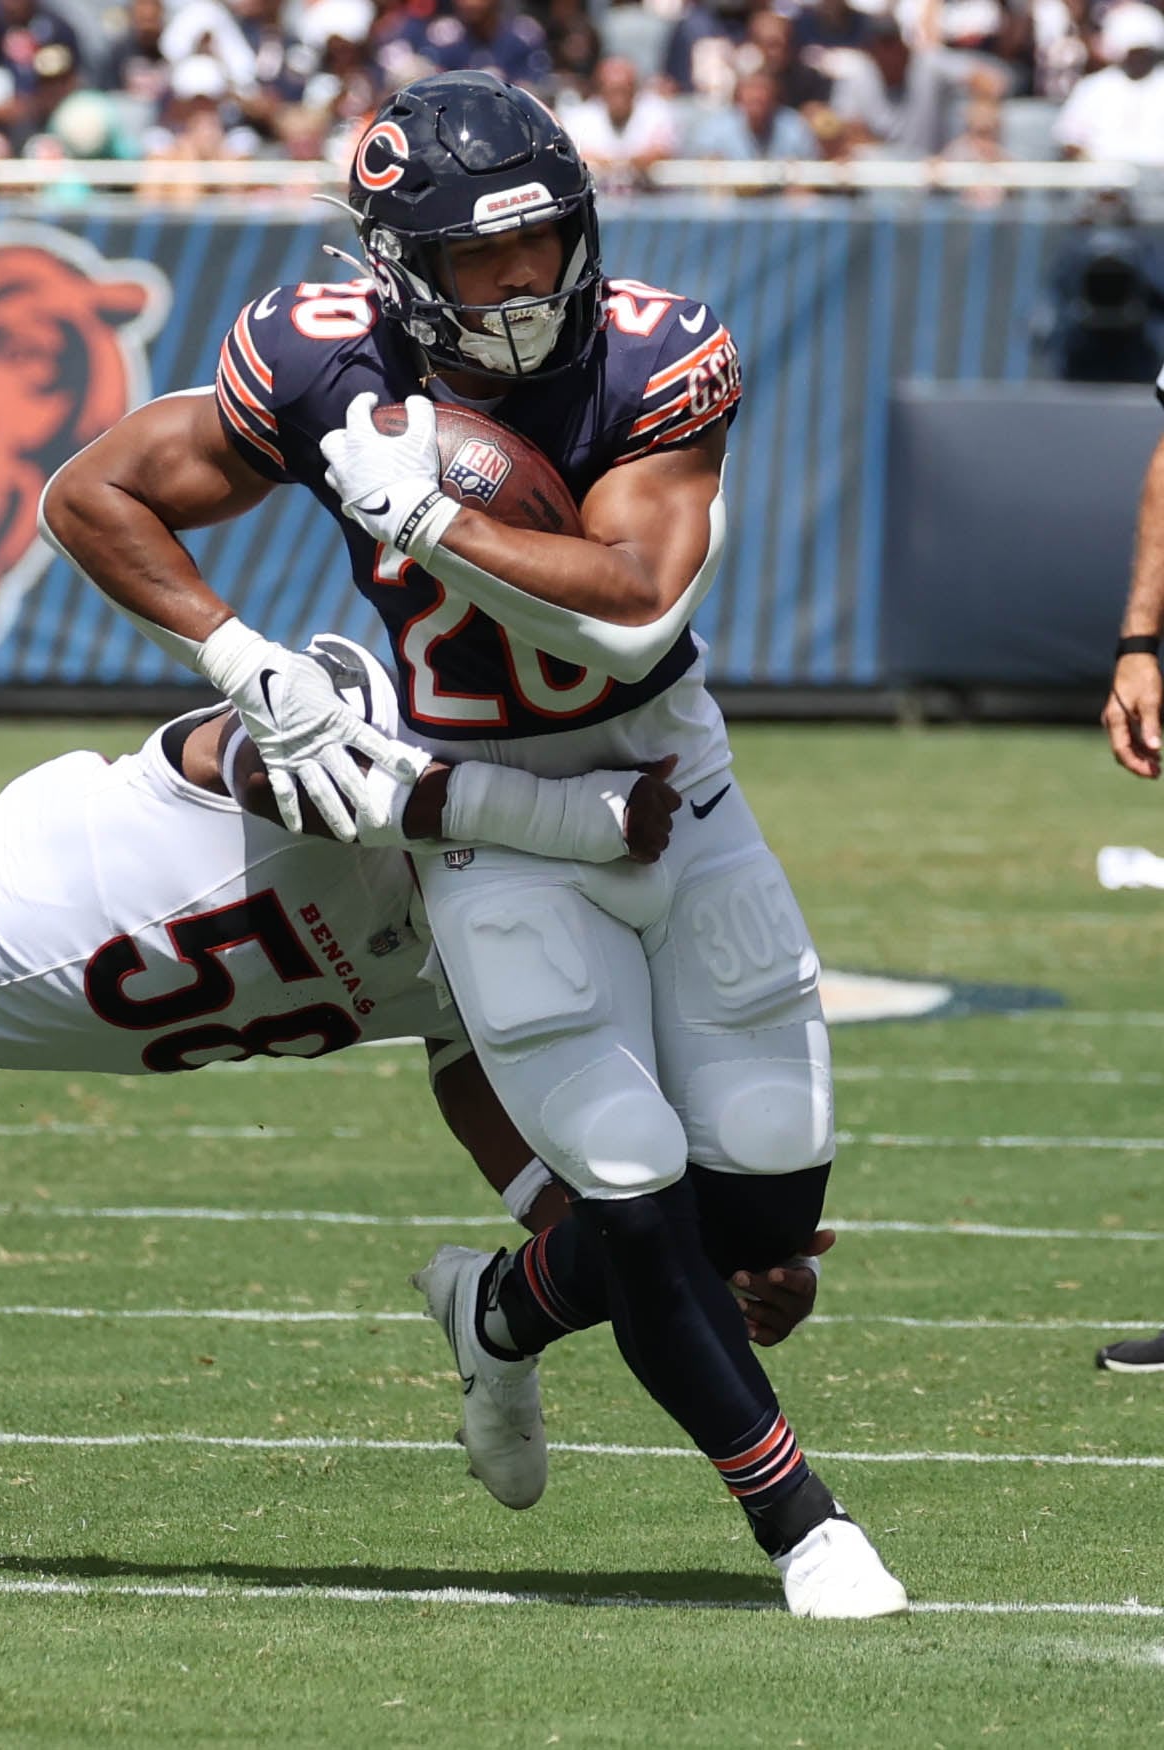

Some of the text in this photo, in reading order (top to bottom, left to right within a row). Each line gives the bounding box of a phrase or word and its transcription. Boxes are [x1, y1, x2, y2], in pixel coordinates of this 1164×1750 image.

[486, 190, 541, 213] BEARS
[465, 443, 506, 482] NFL
[83, 887, 362, 1072] 58
[299, 903, 376, 1016] BENGAS
[692, 877, 806, 985] 305
